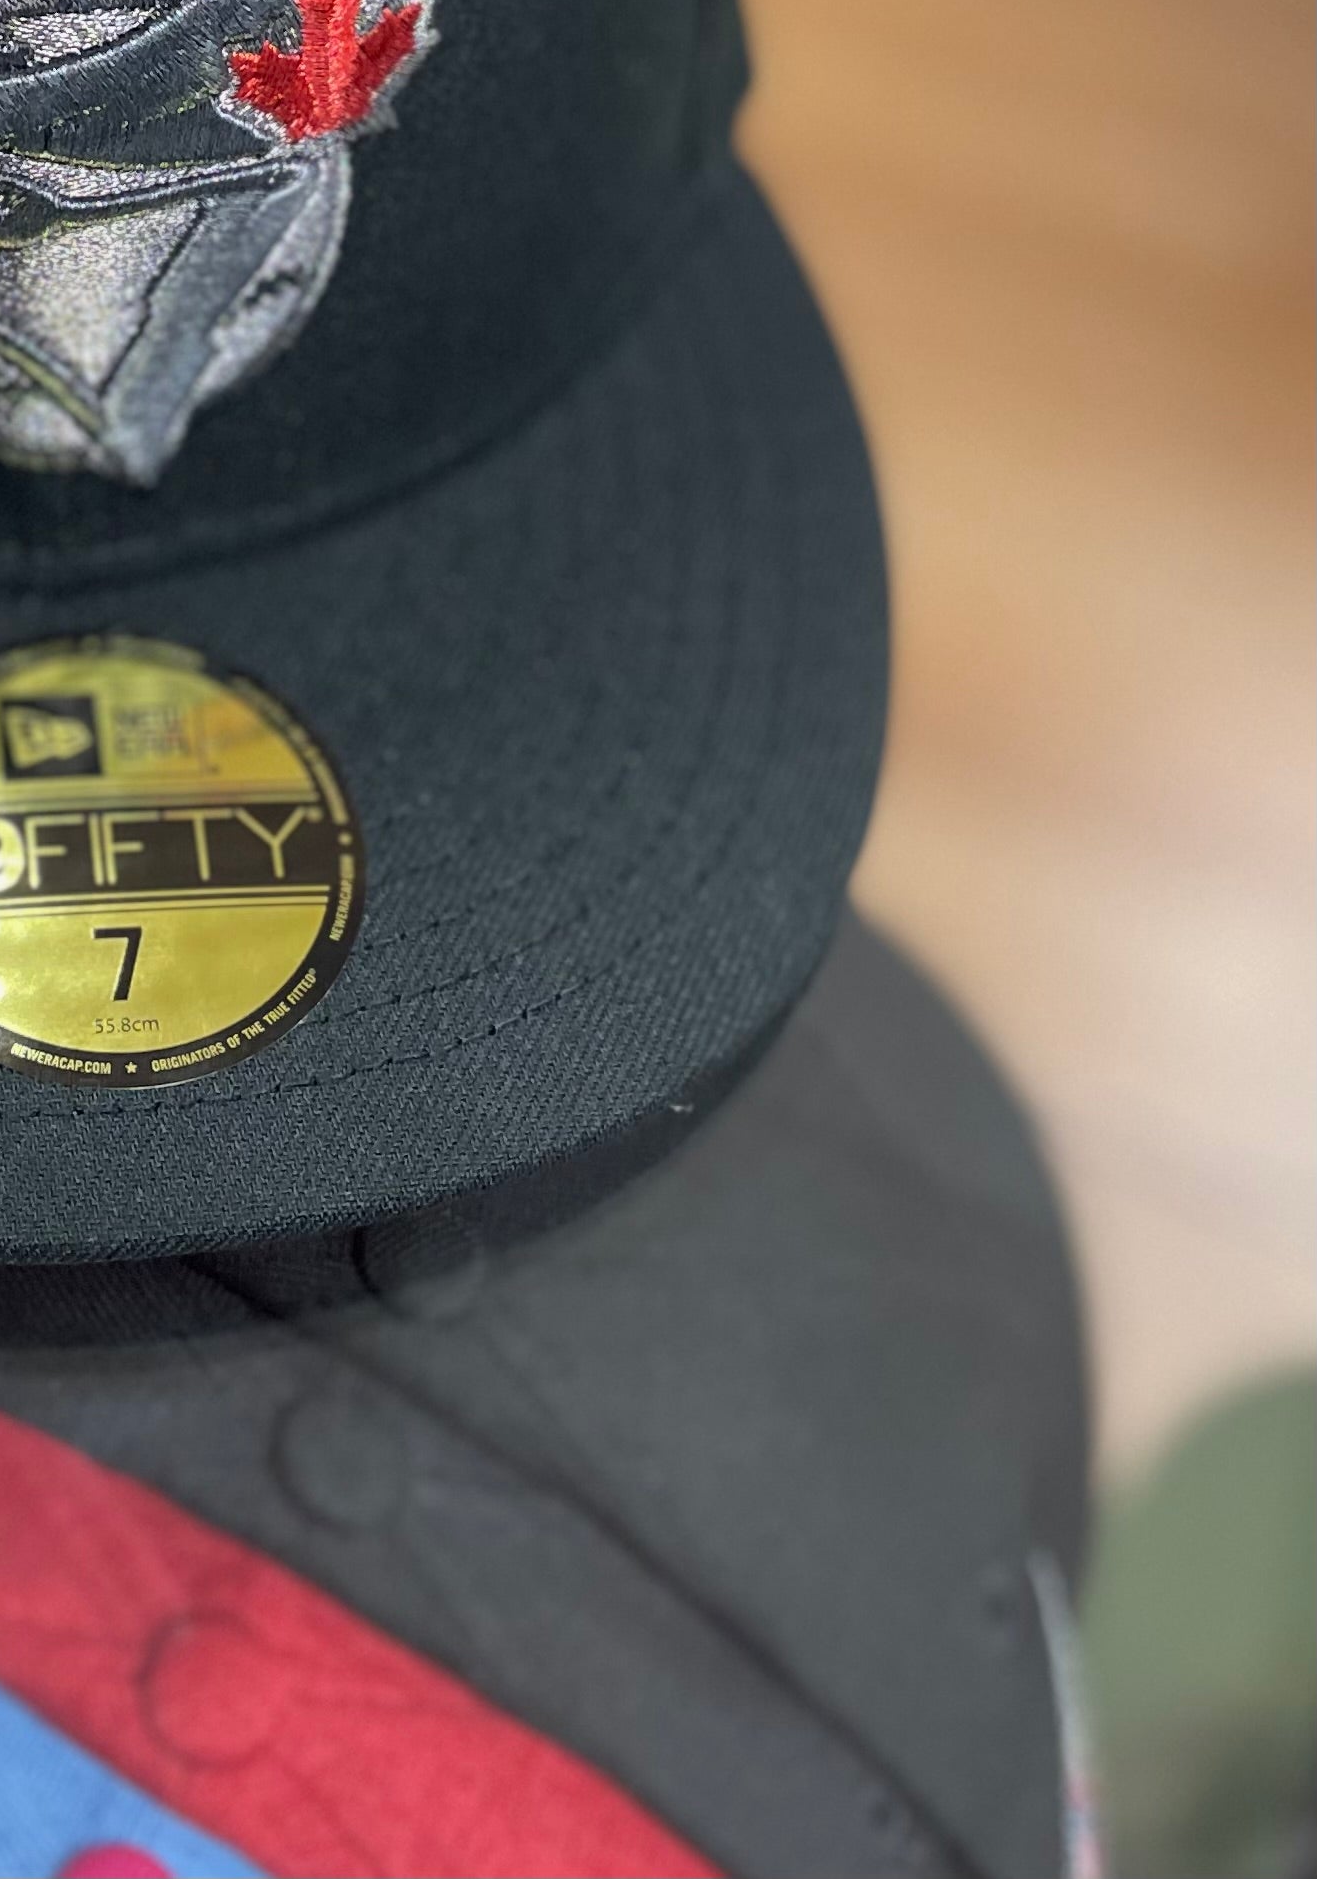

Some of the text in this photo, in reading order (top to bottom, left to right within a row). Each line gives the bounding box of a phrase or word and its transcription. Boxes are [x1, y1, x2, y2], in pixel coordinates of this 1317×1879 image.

[91, 926, 143, 1002] 7
[94, 1016, 161, 1035] 55.8cm
[151, 1042, 225, 1072] ORIGINATORS
[225, 1032, 243, 1050] OF
[240, 1018, 266, 1041] THE
[262, 1000, 291, 1025] TRUE
[10, 1043, 112, 1074] NEWERACAP.COM
